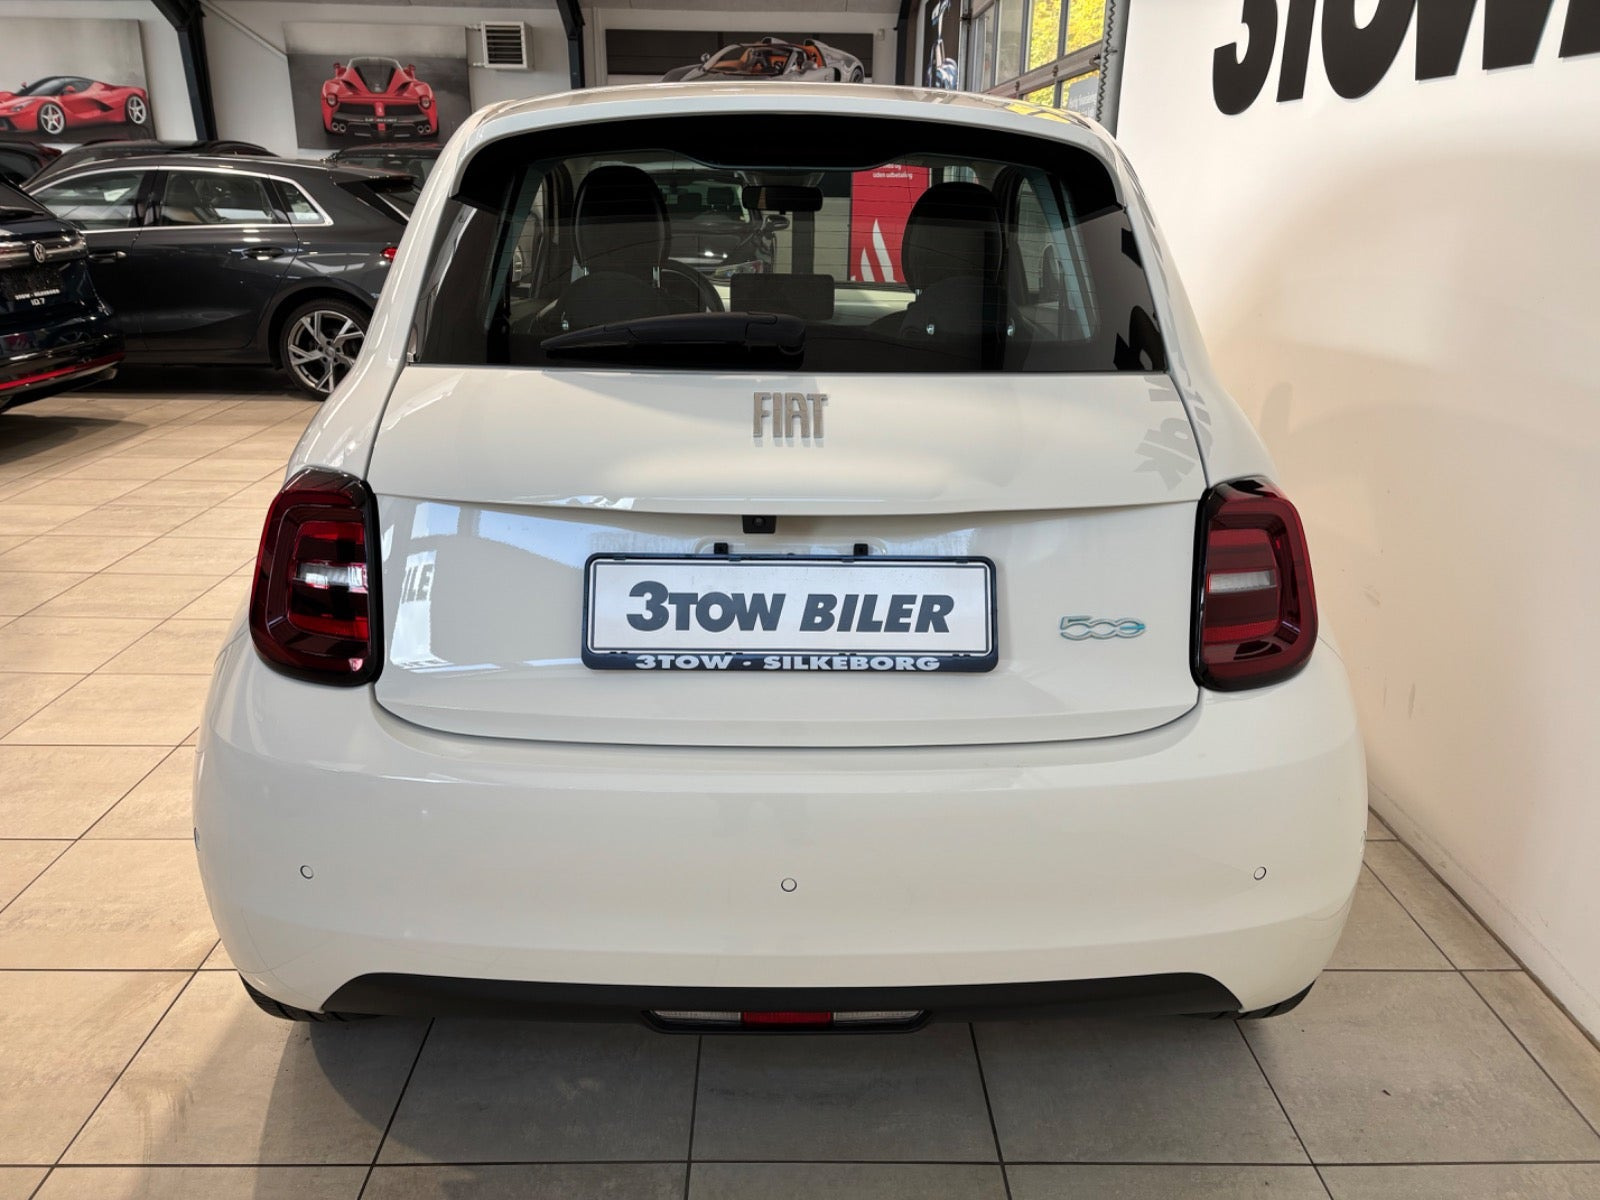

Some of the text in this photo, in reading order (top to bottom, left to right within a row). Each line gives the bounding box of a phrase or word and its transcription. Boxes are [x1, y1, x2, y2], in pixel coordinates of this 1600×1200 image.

[753, 392, 829, 438] FIAT
[626, 581, 955, 633] 3TOW BILER
[1060, 615, 1146, 641] 500
[635, 654, 734, 670] 3TOW
[762, 655, 941, 671] SILKEBORG
